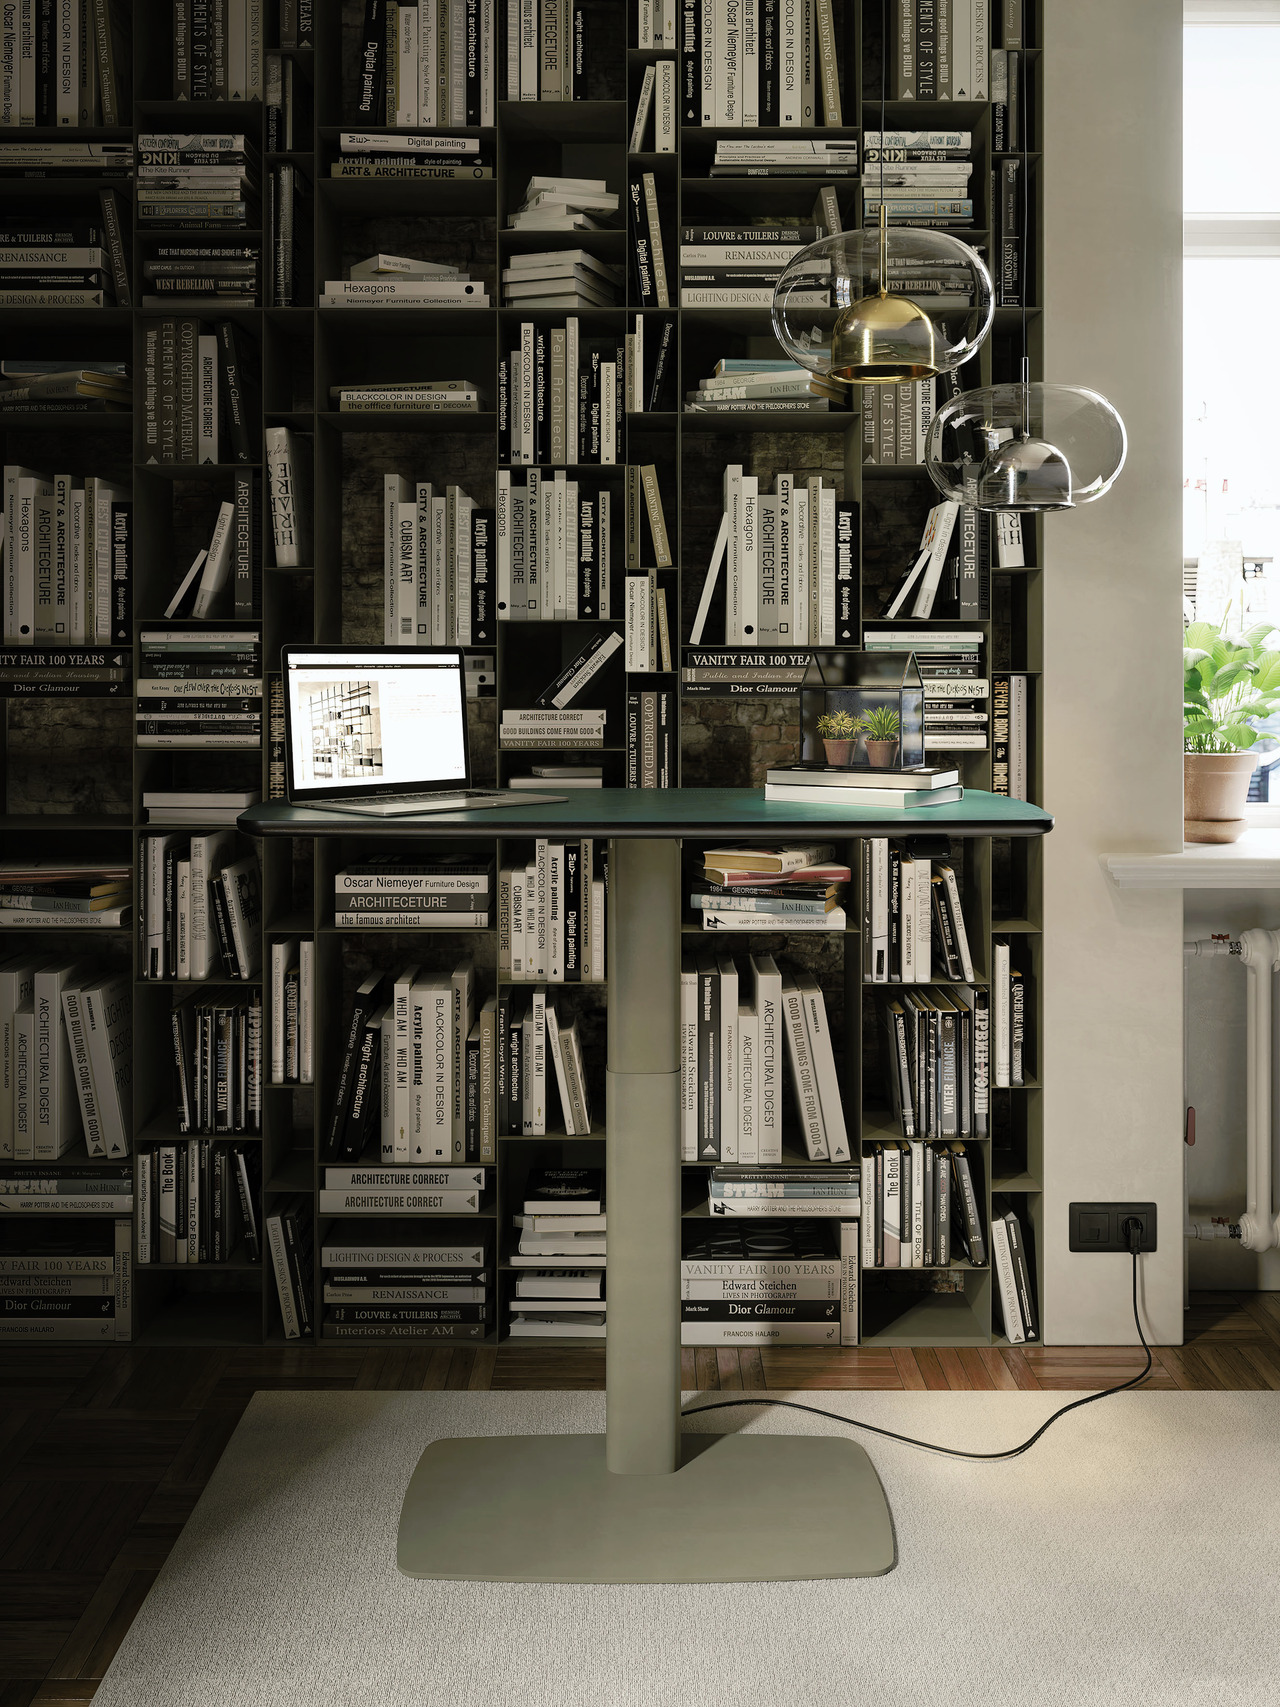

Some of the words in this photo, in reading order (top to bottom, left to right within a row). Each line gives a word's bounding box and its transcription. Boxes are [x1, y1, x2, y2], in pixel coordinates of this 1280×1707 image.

[251, 4, 259, 36] DESIGN
[727, 1, 739, 26] Oscar
[251, 39, 259, 47] &
[468, 17, 476, 78] architecture
[823, 14, 832, 60] PAINTING
[919, 39, 933, 54] OF
[364, 41, 378, 71] Digital
[725, 29, 738, 71] Niemeyer
[251, 49, 259, 87] PROCESS
[919, 62, 933, 95] STYLE
[359, 73, 374, 111] painting
[728, 72, 736, 98] Furniture
[826, 64, 835, 109] Techniques
[726, 98, 736, 120] Design
[407, 138, 432, 147] Digital
[435, 140, 466, 149] painting
[142, 153, 178, 165] KING
[341, 167, 362, 176] ART
[363, 167, 370, 176] &
[375, 168, 455, 178] ARCHITECTURE
[104, 198, 117, 237] Interiors
[111, 239, 121, 268] Atelier
[116, 271, 127, 287] AM
[703, 231, 736, 240] LOUVRE
[743, 231, 779, 240] TUILERIS
[725, 251, 794, 260] RENAISSANCE
[156, 279, 174, 290] WEST
[176, 278, 215, 290] REBELLION
[343, 283, 396, 295] Hexagons
[687, 292, 728, 303] LIGHTING
[731, 292, 763, 303] DESIGN
[147, 330, 157, 365] Whatever
[163, 322, 173, 386] ELEMENTS
[536, 335, 545, 364] wright
[553, 334, 563, 367] Pelli
[181, 322, 193, 402] COPYRIGHTED
[145, 366, 156, 385] good
[203, 356, 213, 405] ARCHITECTURE
[226, 365, 235, 388] Dior
[144, 386, 155, 411] things
[163, 395, 173, 410] OF
[229, 388, 241, 426] Glamour
[415, 393, 447, 401] DESIGN
[537, 367, 545, 422] architecture
[147, 412, 156, 420] ve
[203, 407, 213, 438] CORRECT
[553, 378, 563, 459] Architects
[591, 403, 600, 425] Digital
[147, 421, 157, 444] BUILD
[163, 419, 173, 459] STYLE
[181, 404, 193, 460] MATERIAL
[591, 427, 600, 455] painting
[19, 497, 31, 553] Hexagons
[744, 497, 755, 552] Hexagons
[838, 511, 852, 540] Acrylic
[401, 520, 412, 560] CUBISM
[401, 562, 412, 583] ART
[838, 541, 852, 581] painting
[20, 656, 47, 665] FAIR
[49, 656, 66, 665] 100
[68, 656, 105, 665] YEARS
[693, 656, 737, 665] VANITY
[740, 655, 766, 665] FAIR
[769, 655, 787, 665] 100
[730, 685, 754, 693] Dior
[757, 685, 797, 693] Glamour
[343, 877, 373, 888] Oscar
[376, 877, 423, 890] Niemeyer
[425, 880, 455, 888] Furniture
[457, 880, 480, 889] Design
[701, 896, 756, 911] STEAM
[781, 902, 793, 911] IAN
[795, 903, 814, 912] HUNT
[341, 914, 353, 925] the
[356, 914, 384, 925] famous
[385, 914, 421, 925] architect
[788, 997, 799, 1019] GOOD
[40, 998, 49, 1084] ARCHITECTURAL
[362, 1032, 374, 1061] wright
[436, 999, 444, 1069] BLACKCOLOR
[765, 999, 774, 1087] ARCHITECTURAL
[793, 1022, 808, 1066] BUILDINGS
[944, 1041, 954, 1082] FINANCE
[436, 1073, 444, 1082] IN
[800, 1068, 811, 1093] COME
[352, 1063, 367, 1119] architecture
[944, 1084, 954, 1115] WATER
[40, 1088, 49, 1125] DIGEST
[436, 1086, 444, 1125] DESIGN
[765, 1090, 774, 1128] DIGEST
[805, 1095, 816, 1118] FROM
[810, 1122, 822, 1145] GOOD
[351, 1174, 411, 1184] ARCHITECTURE
[412, 1174, 449, 1184] CORRECT
[888, 1157, 898, 1181] Book
[887, 1183, 898, 1198] The
[329, 1253, 374, 1262] LIGHTING
[376, 1253, 410, 1262] DESIGN
[413, 1253, 420, 1262] &
[423, 1253, 463, 1262] PROCESS
[686, 1265, 736, 1275] VANITY
[738, 1265, 768, 1275] FAIR
[772, 1265, 793, 1275] 100
[796, 1265, 835, 1275] YEARS
[372, 1291, 448, 1299] RENAISSANCE
[722, 1280, 756, 1290] Edward
[759, 1280, 797, 1290] Steichen
[728, 1304, 751, 1314] Dior
[755, 1303, 796, 1314] Glamour
[336, 1326, 386, 1335] Interiors
[390, 1326, 428, 1335] Atelier
[432, 1326, 454, 1335] AM
